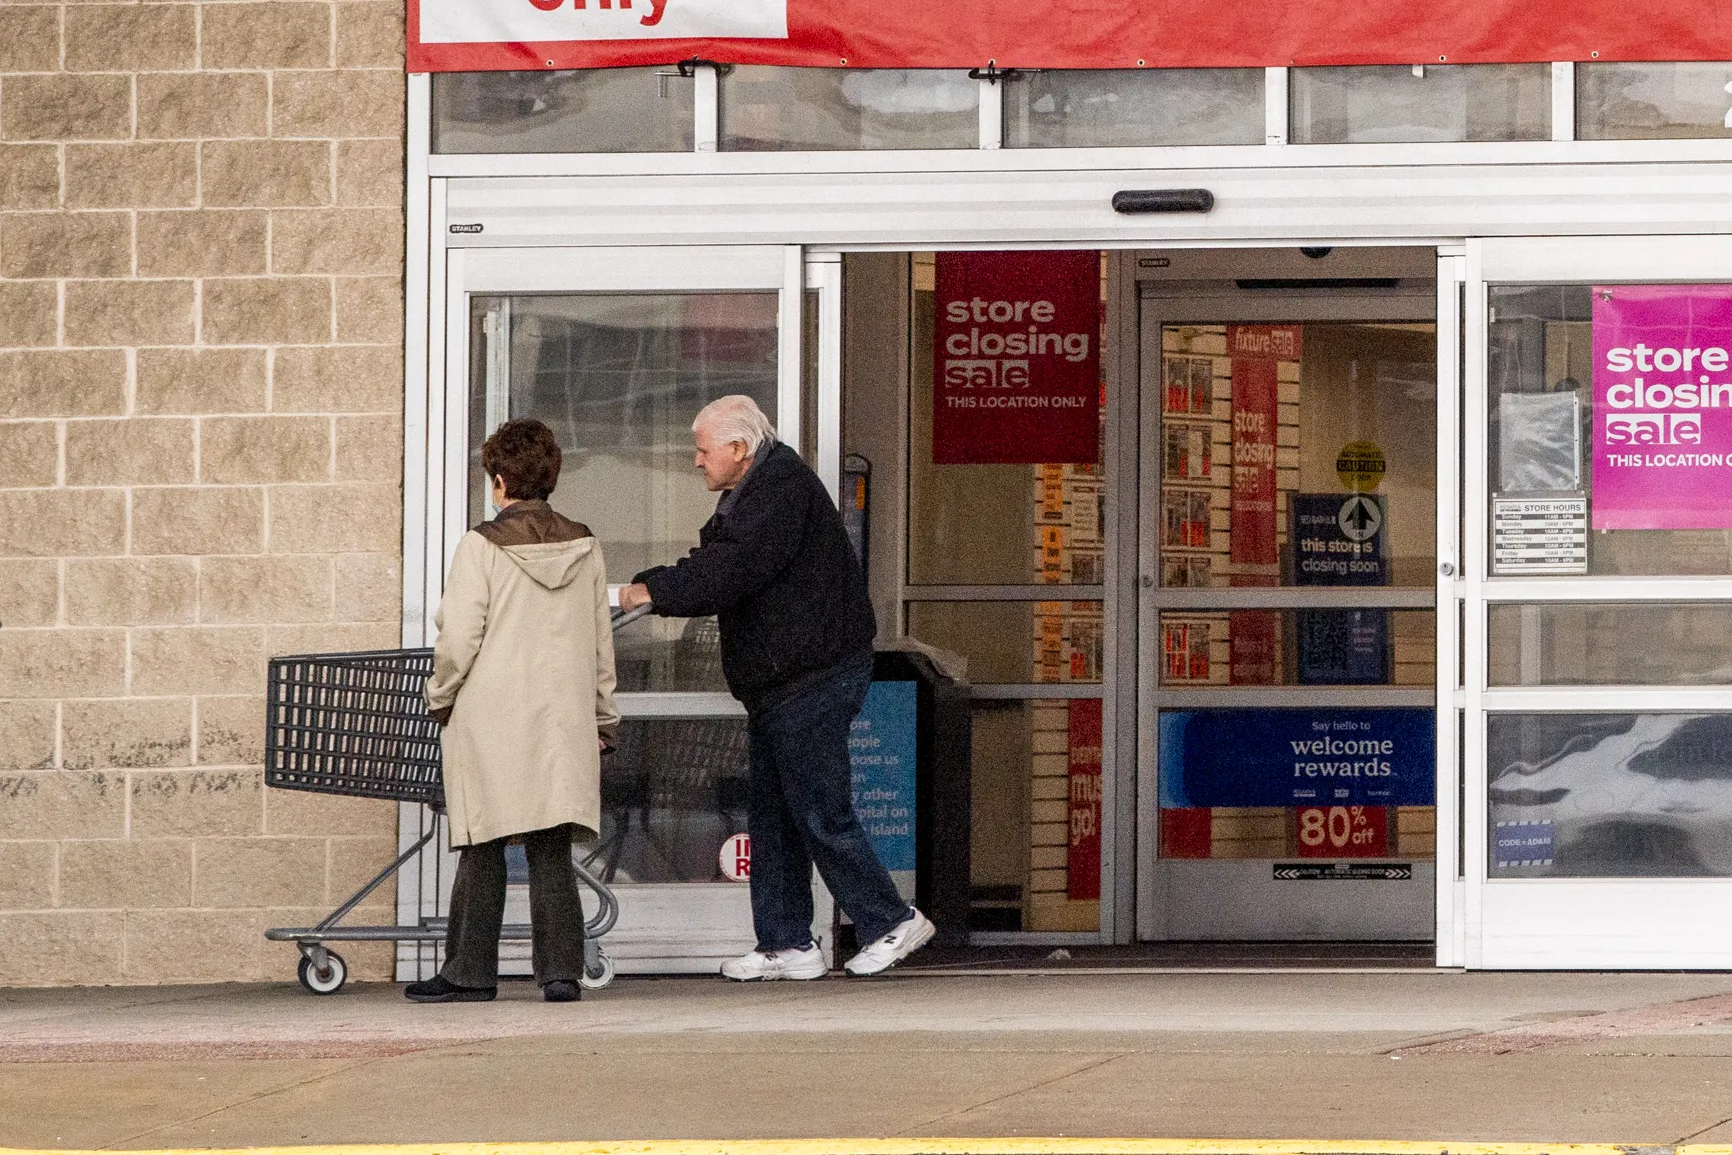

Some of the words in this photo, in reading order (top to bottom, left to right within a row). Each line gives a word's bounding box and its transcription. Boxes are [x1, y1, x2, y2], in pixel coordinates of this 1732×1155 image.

[946, 296, 1055, 324] store
[946, 325, 1089, 362] closing
[1606, 344, 1729, 373] store
[945, 359, 1030, 389] sale
[946, 396, 976, 408] THIS
[979, 395, 1049, 408] LOCATION
[1051, 394, 1088, 408] ONLY
[1234, 408, 1265, 433] store
[1606, 414, 1700, 445] sale
[1234, 436, 1274, 470] closing
[1607, 454, 1643, 467] THIS
[1645, 453, 1723, 467] LOCATION
[1524, 504, 1551, 512] STORE
[1301, 537, 1326, 552] this
[1328, 539, 1360, 552] store
[1363, 540, 1373, 552] is
[1301, 558, 1347, 576] closing
[1349, 561, 1379, 573] soon
[850, 721, 870, 731] ore
[1312, 721, 1331, 732] Say
[1333, 720, 1358, 730] hello
[1360, 721, 1371, 730] to
[1290, 735, 1394, 755] welcome
[885, 755, 900, 765] us
[1294, 757, 1392, 777] rewards
[863, 788, 897, 800] other
[891, 808, 908, 818] on
[1351, 827, 1375, 844] off
[1527, 837, 1551, 845] ADAM
